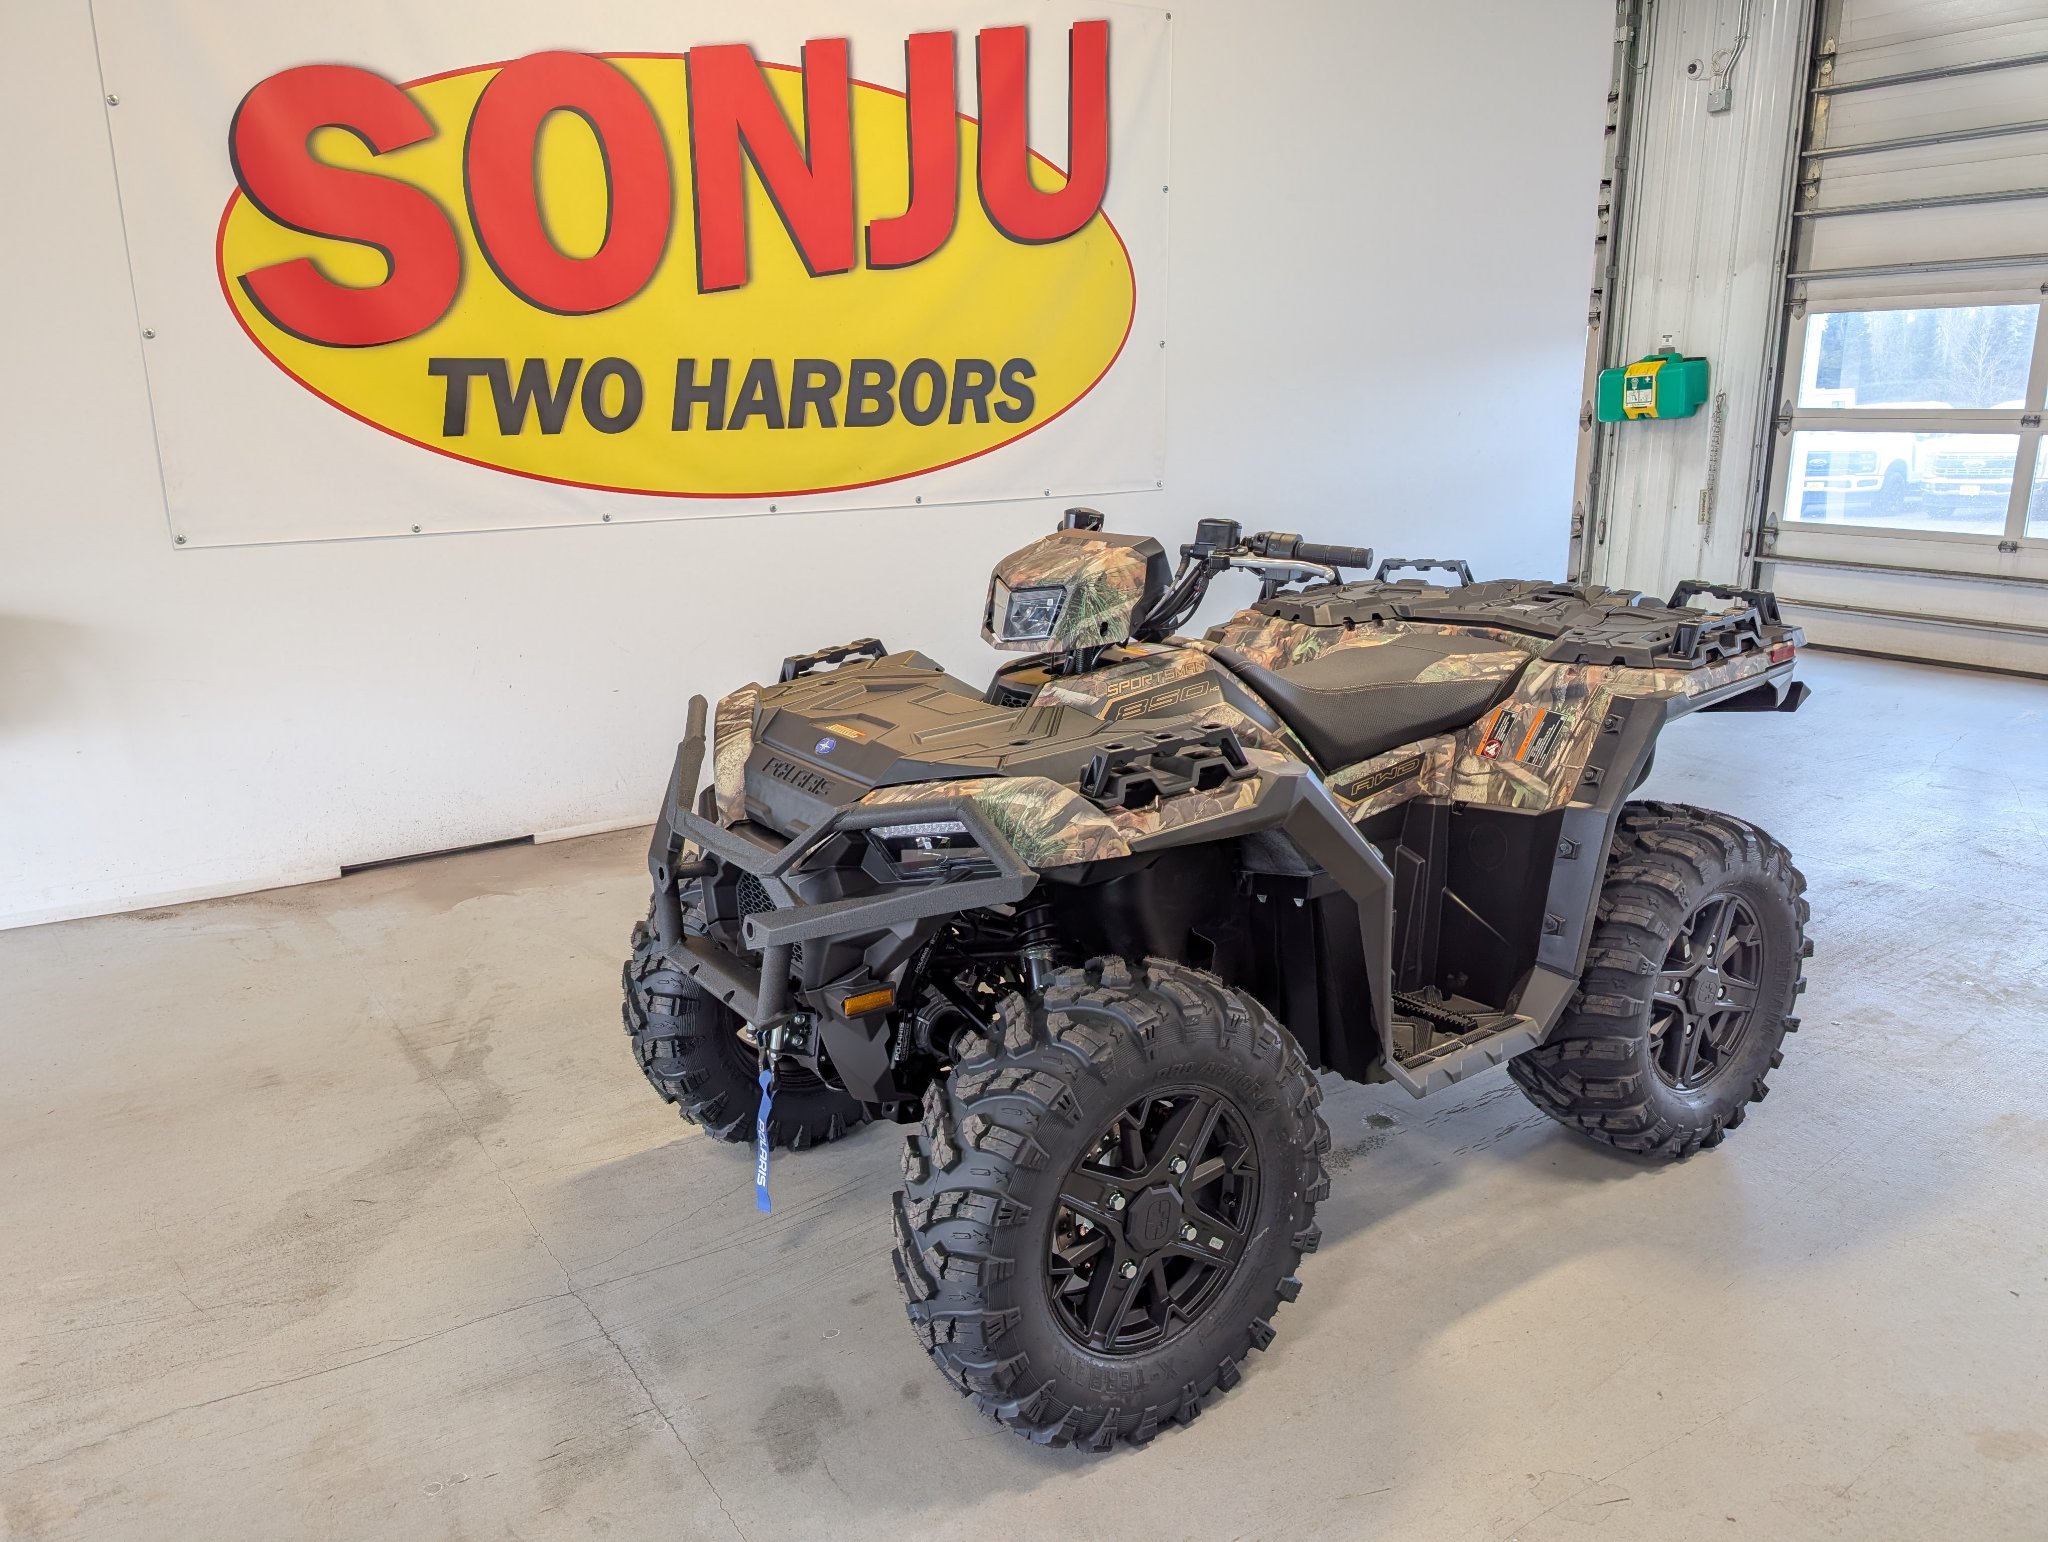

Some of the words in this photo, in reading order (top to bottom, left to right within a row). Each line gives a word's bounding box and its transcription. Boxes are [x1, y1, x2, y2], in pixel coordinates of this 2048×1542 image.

[229, 19, 1109, 348] SONJU
[428, 356, 643, 437] TWO
[671, 357, 1036, 431] HARBORS
[1106, 660, 1207, 698] SPORTSMAN
[1115, 680, 1210, 721] 850
[762, 757, 838, 796] POLARIS
[1350, 758, 1420, 796] AWD
[894, 1021, 905, 1061] POLARIS
[756, 1117, 769, 1187] POLARIS
